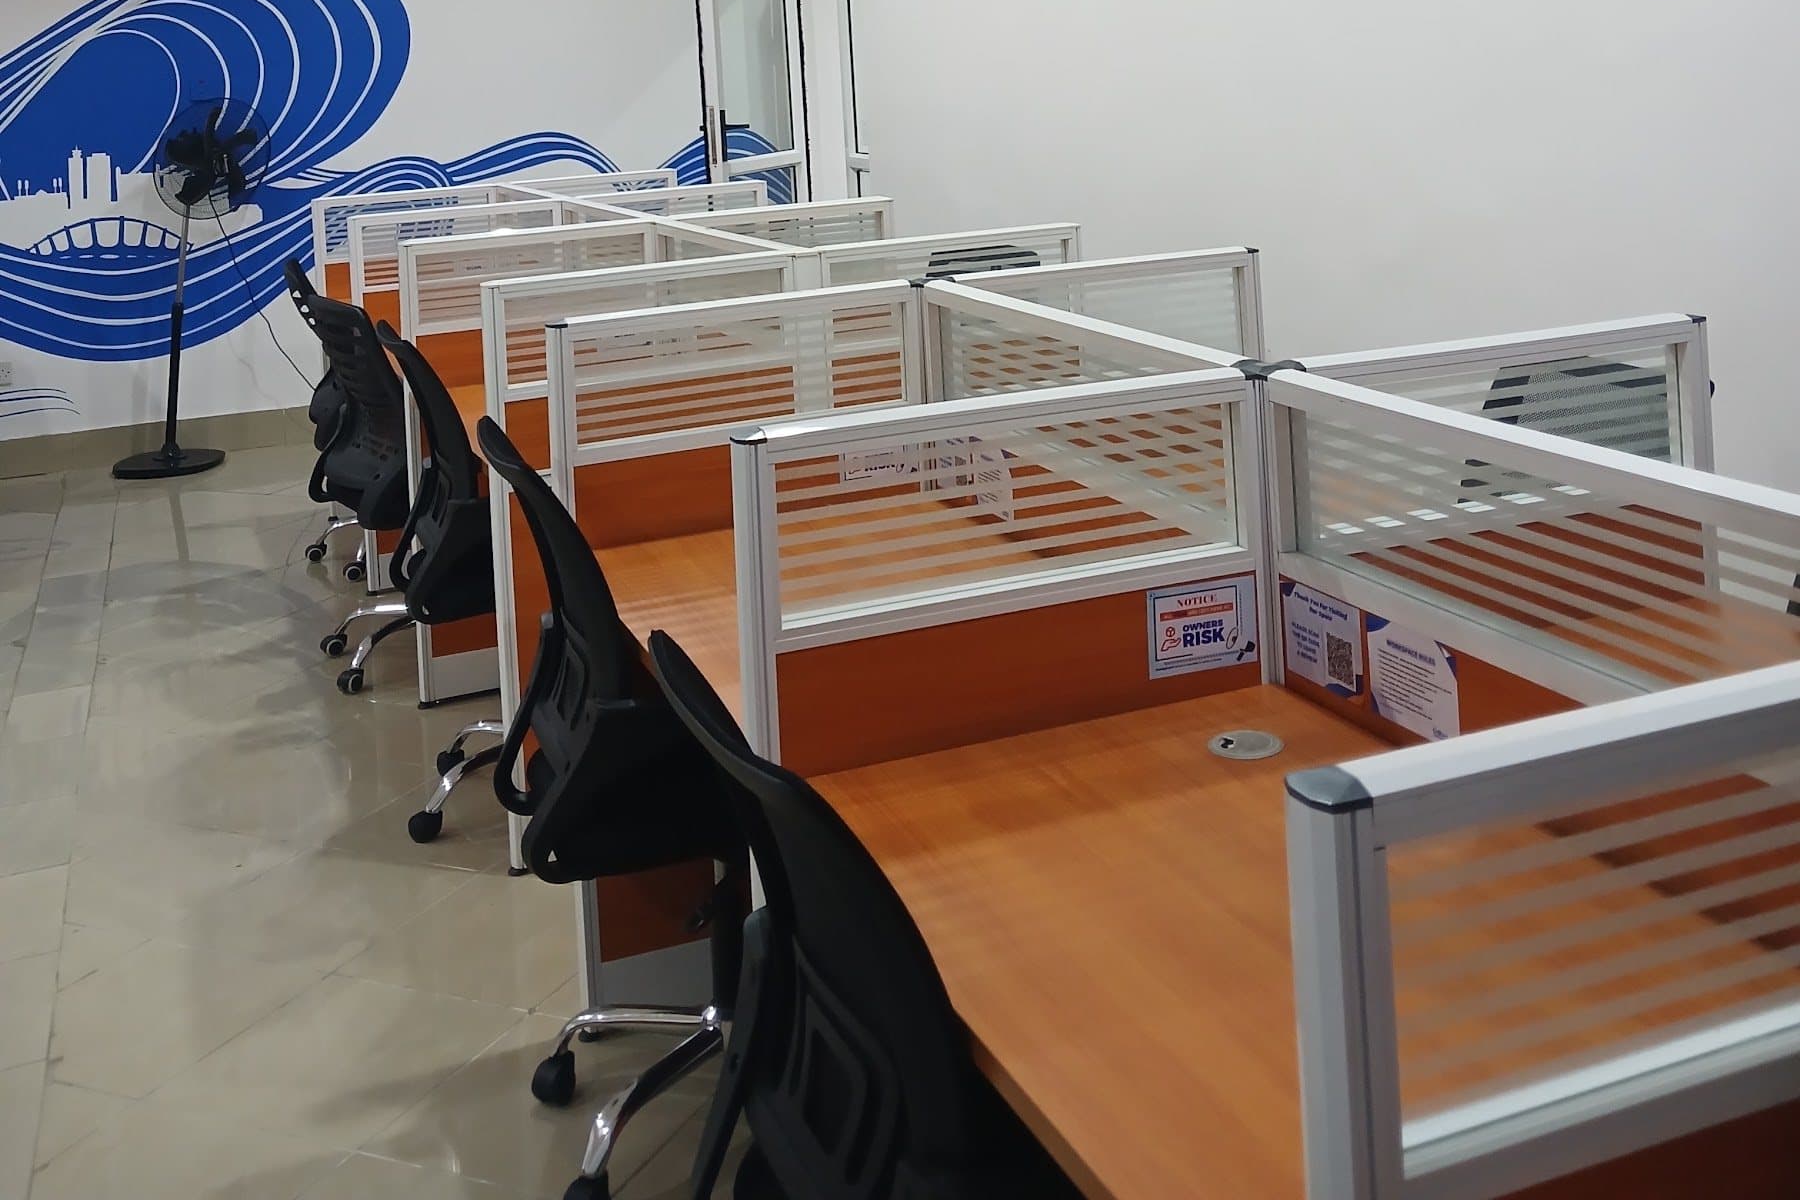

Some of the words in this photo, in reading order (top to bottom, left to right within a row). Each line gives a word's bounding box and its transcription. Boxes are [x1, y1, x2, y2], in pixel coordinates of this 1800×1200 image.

[1177, 593, 1217, 608] NOTICE
[1182, 619, 1224, 633] OWNERS
[1182, 627, 1225, 648] RISK
